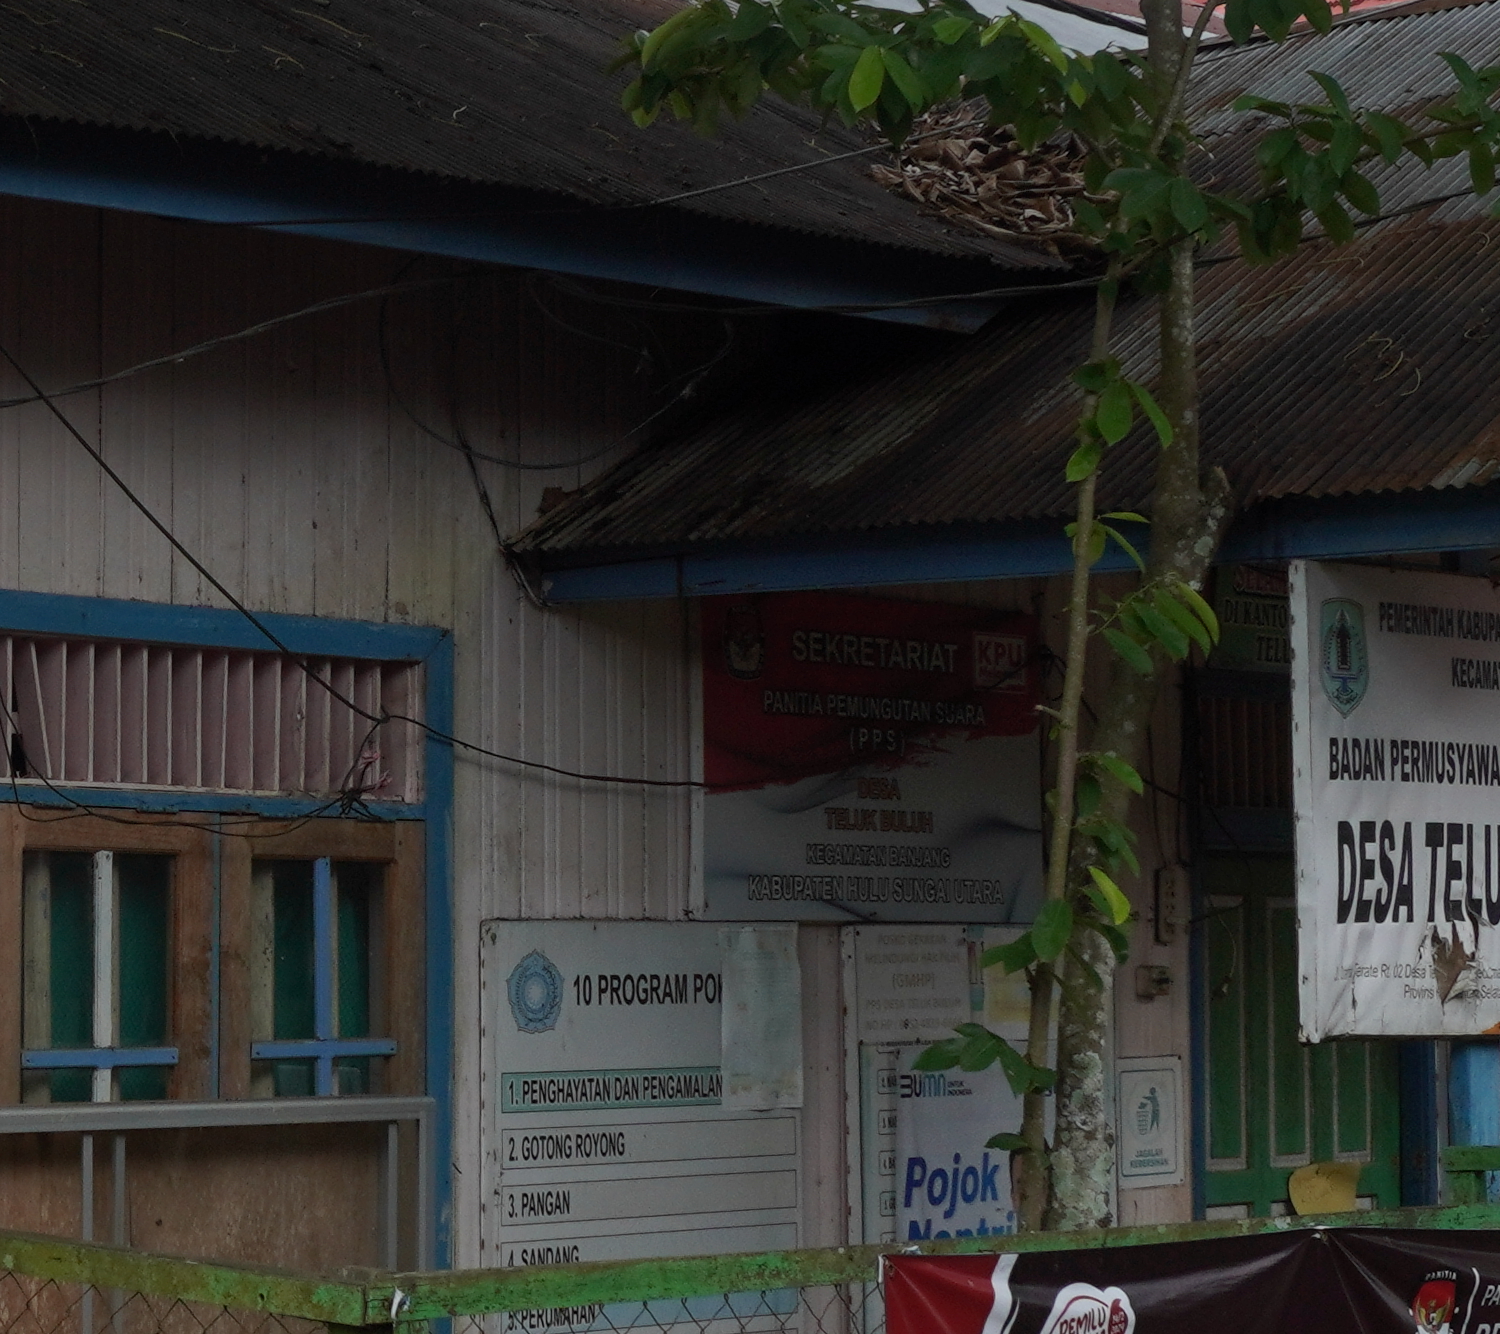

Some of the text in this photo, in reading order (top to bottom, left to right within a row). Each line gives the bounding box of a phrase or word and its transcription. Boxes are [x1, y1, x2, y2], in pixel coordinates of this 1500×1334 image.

[1378, 602, 1454, 635] PEMERINTAH
[792, 631, 958, 671] SEKRETARIAT
[1329, 737, 1385, 780] BADAN
[1335, 820, 1414, 924] DESA
[574, 974, 687, 1005] 10 PROGRAM
[521, 1076, 639, 1104] PENGHAYATAN DAN
[522, 1132, 625, 1161] GOTONG ROYONG
[905, 1154, 999, 1219] Pojok
[522, 1191, 570, 1216] PANGAN
